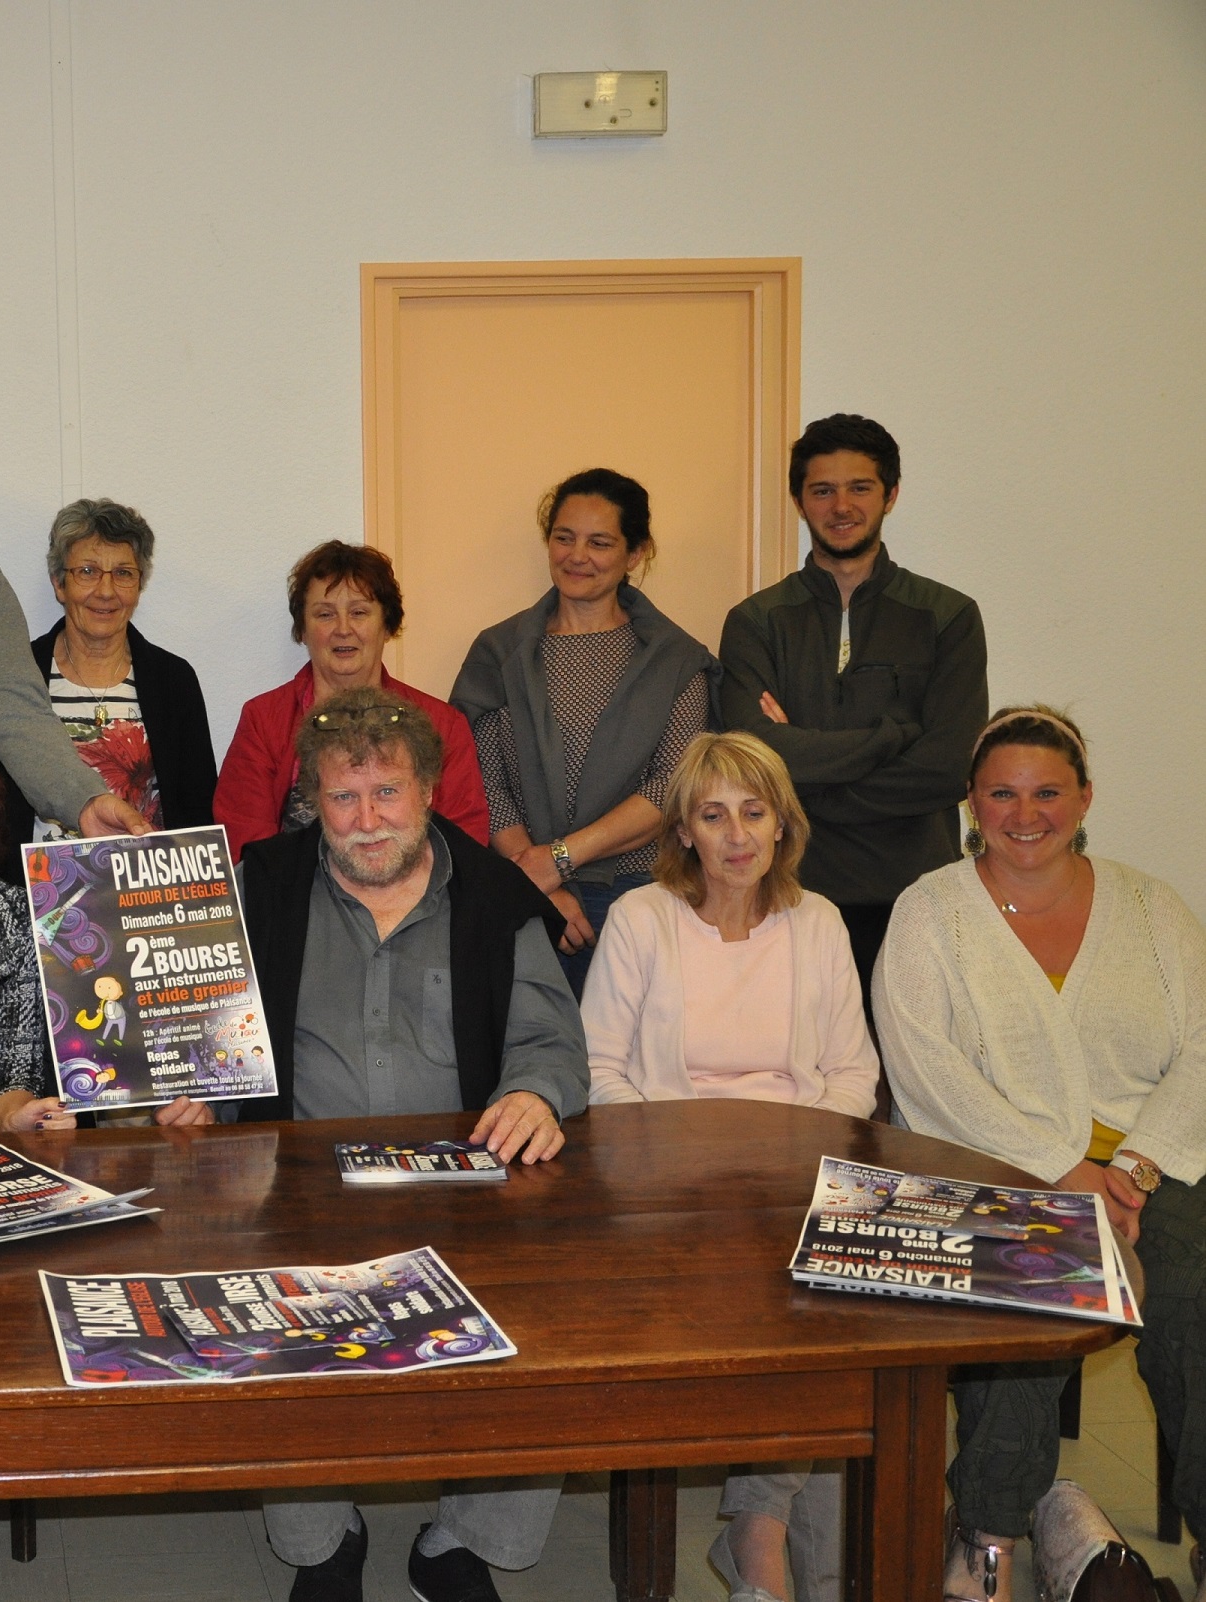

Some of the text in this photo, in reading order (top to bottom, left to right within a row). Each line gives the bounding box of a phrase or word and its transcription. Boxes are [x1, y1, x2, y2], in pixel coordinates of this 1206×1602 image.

[111, 843, 225, 890] PLAISANCE
[119, 882, 228, 907] AUTOUR DE L'ÉGLISE
[121, 903, 233, 930] Dimanche 6 mai 2018
[152, 941, 242, 975] BOURSE
[134, 966, 246, 992] aux instruments
[137, 980, 249, 1006] et vide grenier
[139, 997, 252, 1019] de l'école de musique de Plaisance
[146, 1050, 180, 1063] Repas
[150, 1062, 196, 1076] solidaire
[892, 1200, 948, 1213] BOURSE
[818, 1220, 938, 1241] BOURSE
[812, 1243, 972, 1266] Dimanche 6 mai 2018
[805, 1257, 972, 1291] PLAISANCE
[66, 1281, 140, 1337] PLAISANCE
[174, 1308, 219, 1335] PLAISANCE
